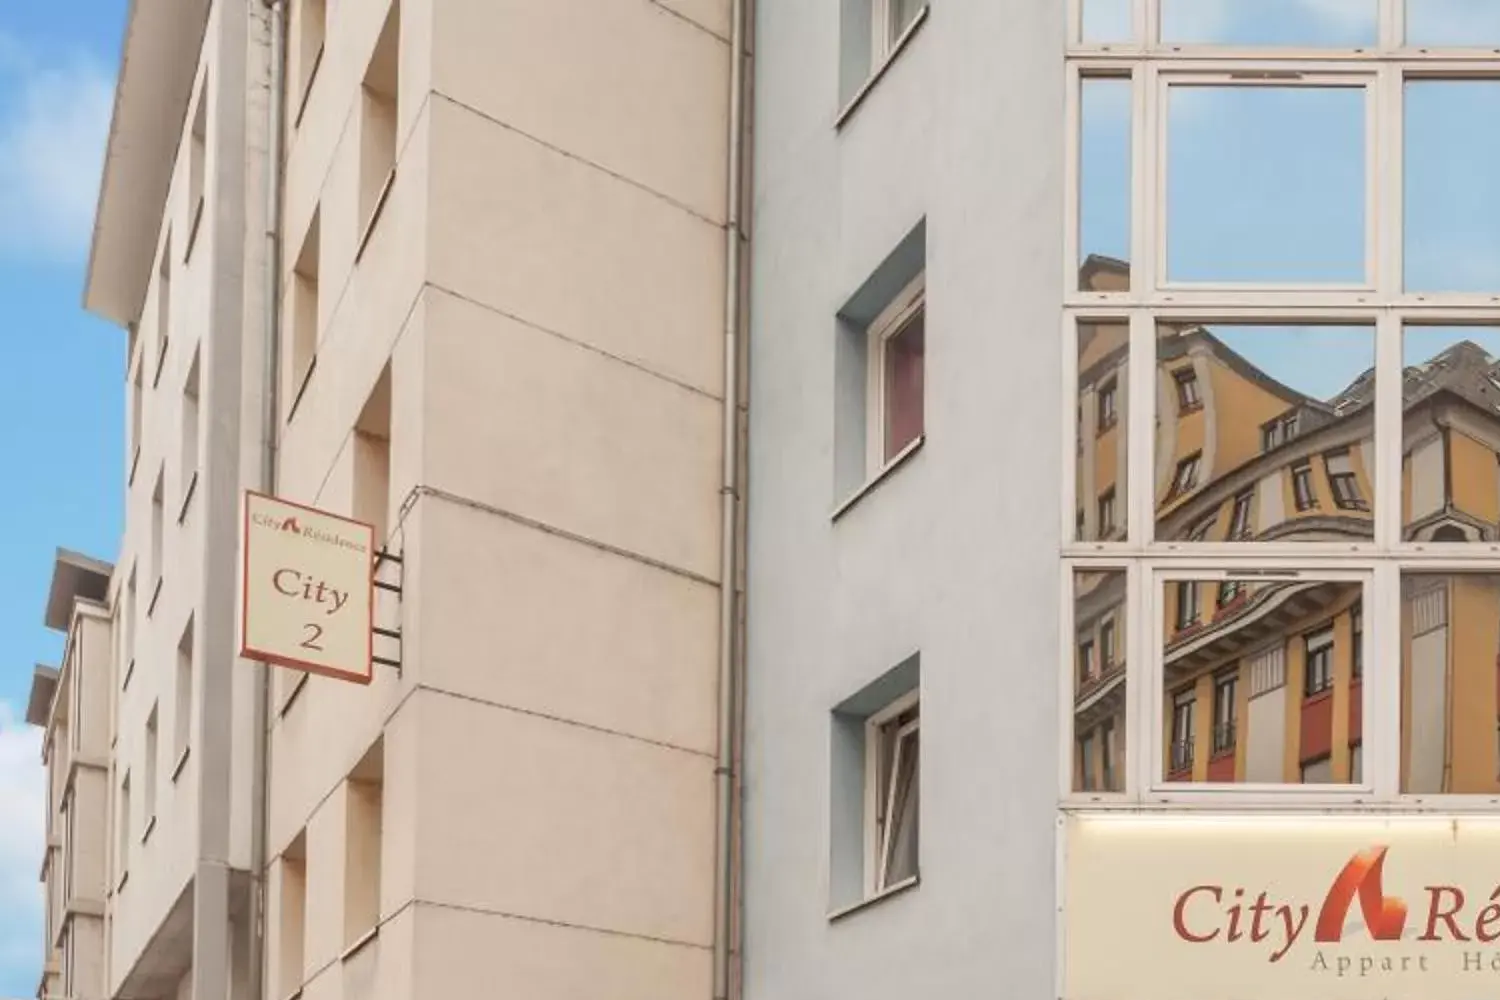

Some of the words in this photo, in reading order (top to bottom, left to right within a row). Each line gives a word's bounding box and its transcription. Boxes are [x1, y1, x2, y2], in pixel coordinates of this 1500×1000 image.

[252, 512, 282, 531] City
[272, 568, 350, 615] City
[300, 623, 325, 652] 2
[1172, 885, 1309, 964] City
[1310, 951, 1429, 977] Appart
